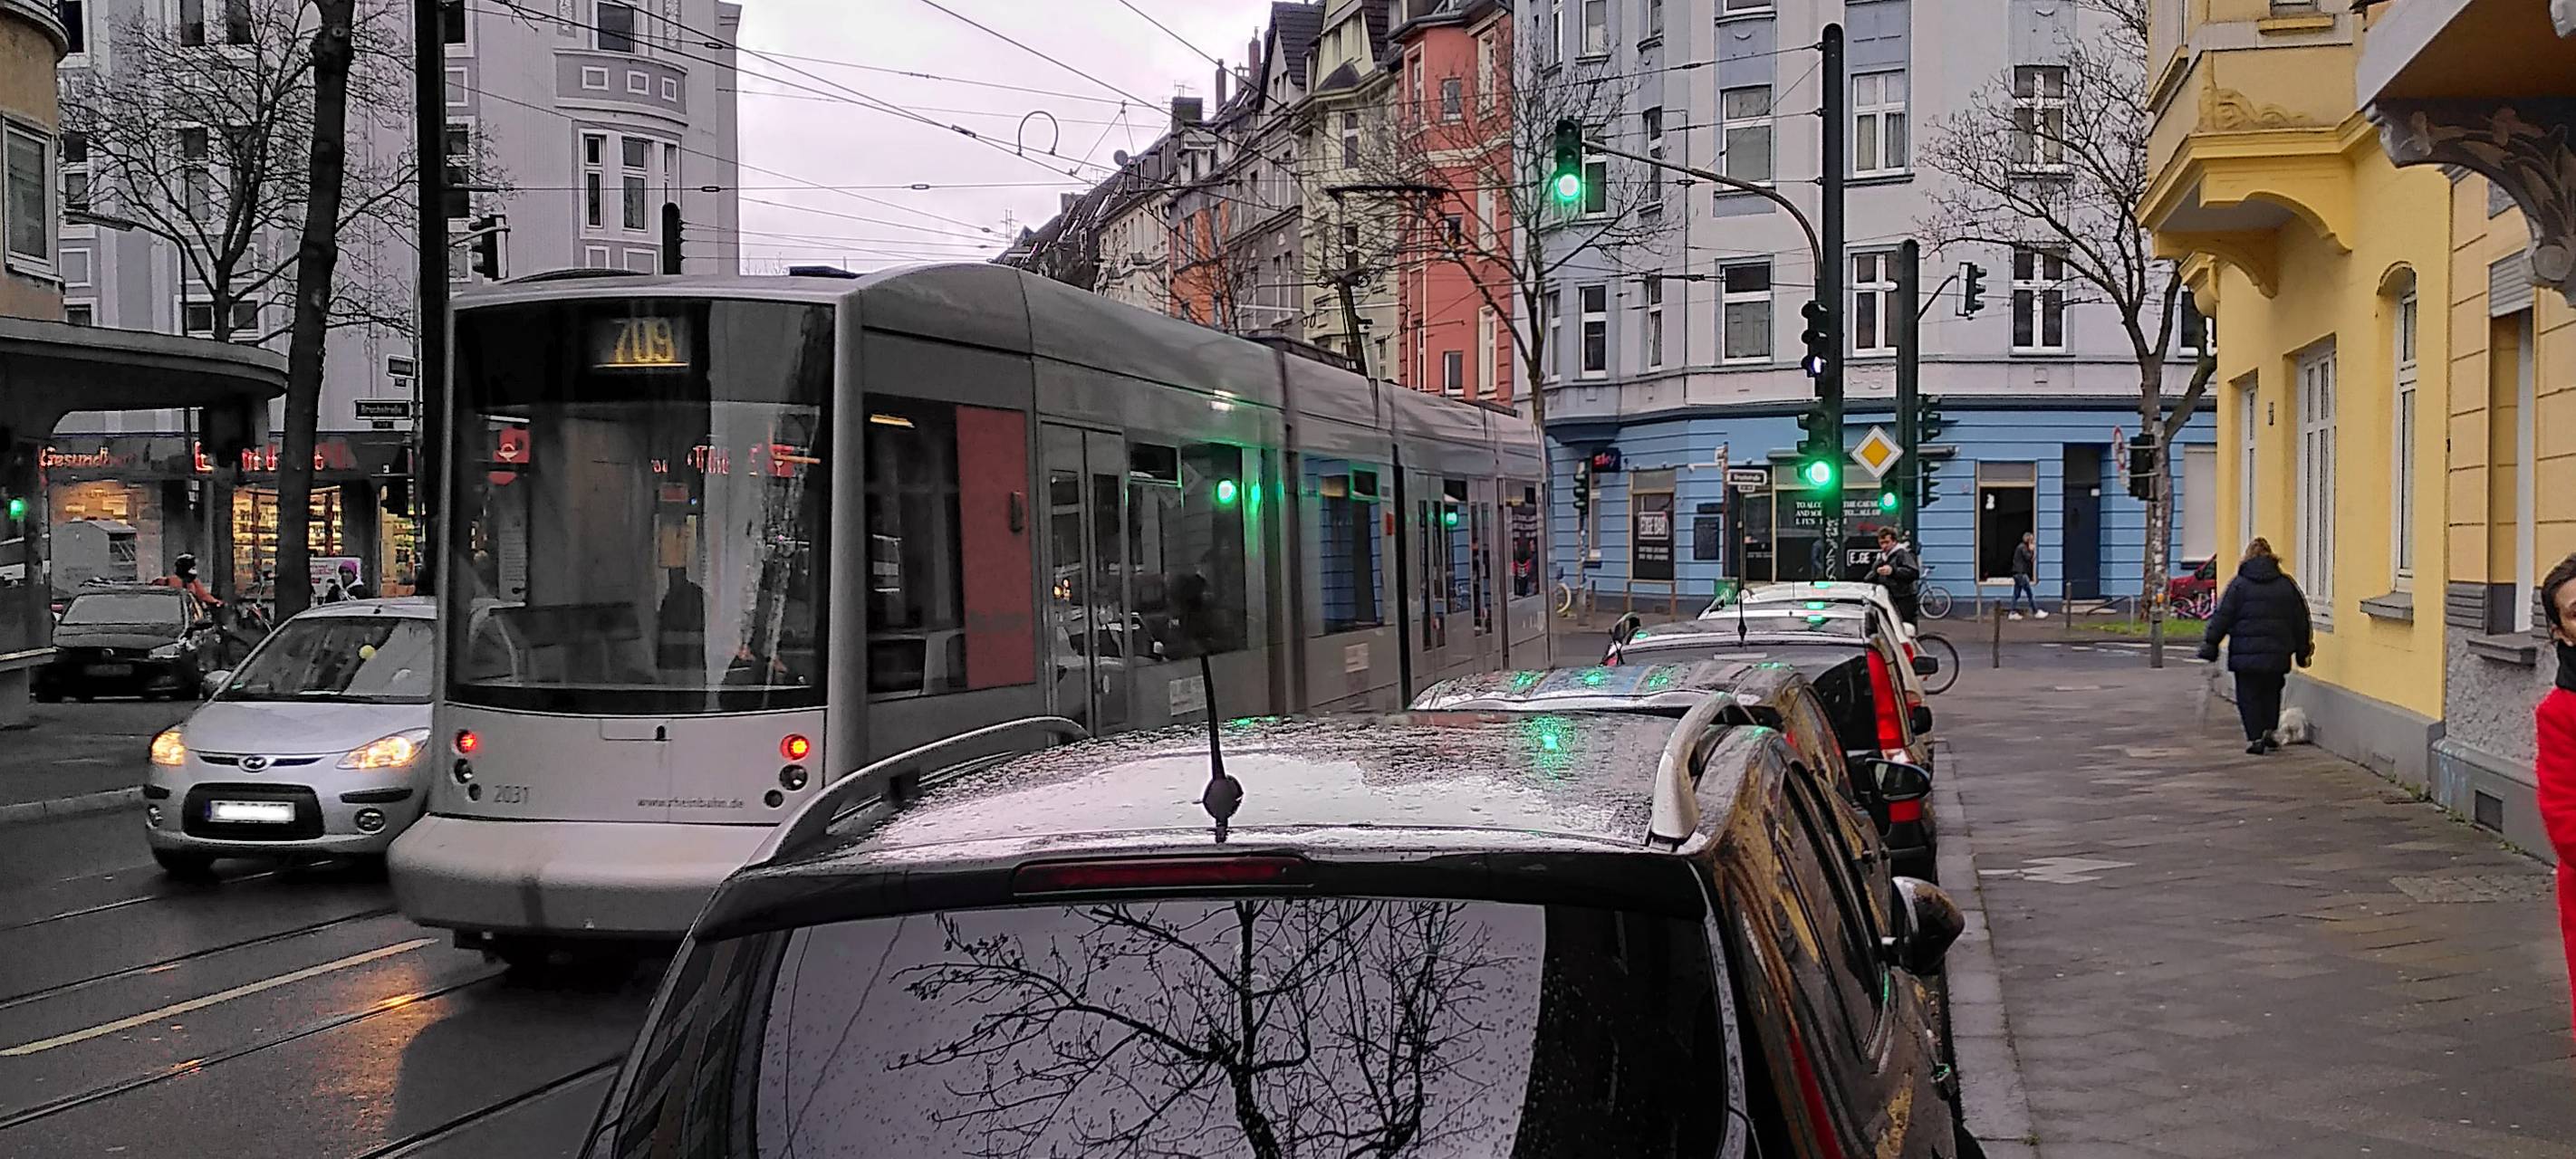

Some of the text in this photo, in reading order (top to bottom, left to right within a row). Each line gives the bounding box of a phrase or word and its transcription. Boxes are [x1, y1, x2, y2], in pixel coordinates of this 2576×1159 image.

[614, 318, 676, 362] 709
[1594, 452, 1616, 467] sky
[494, 784, 533, 804] 2031
[637, 797, 745, 809] www.rheinbahn.de
